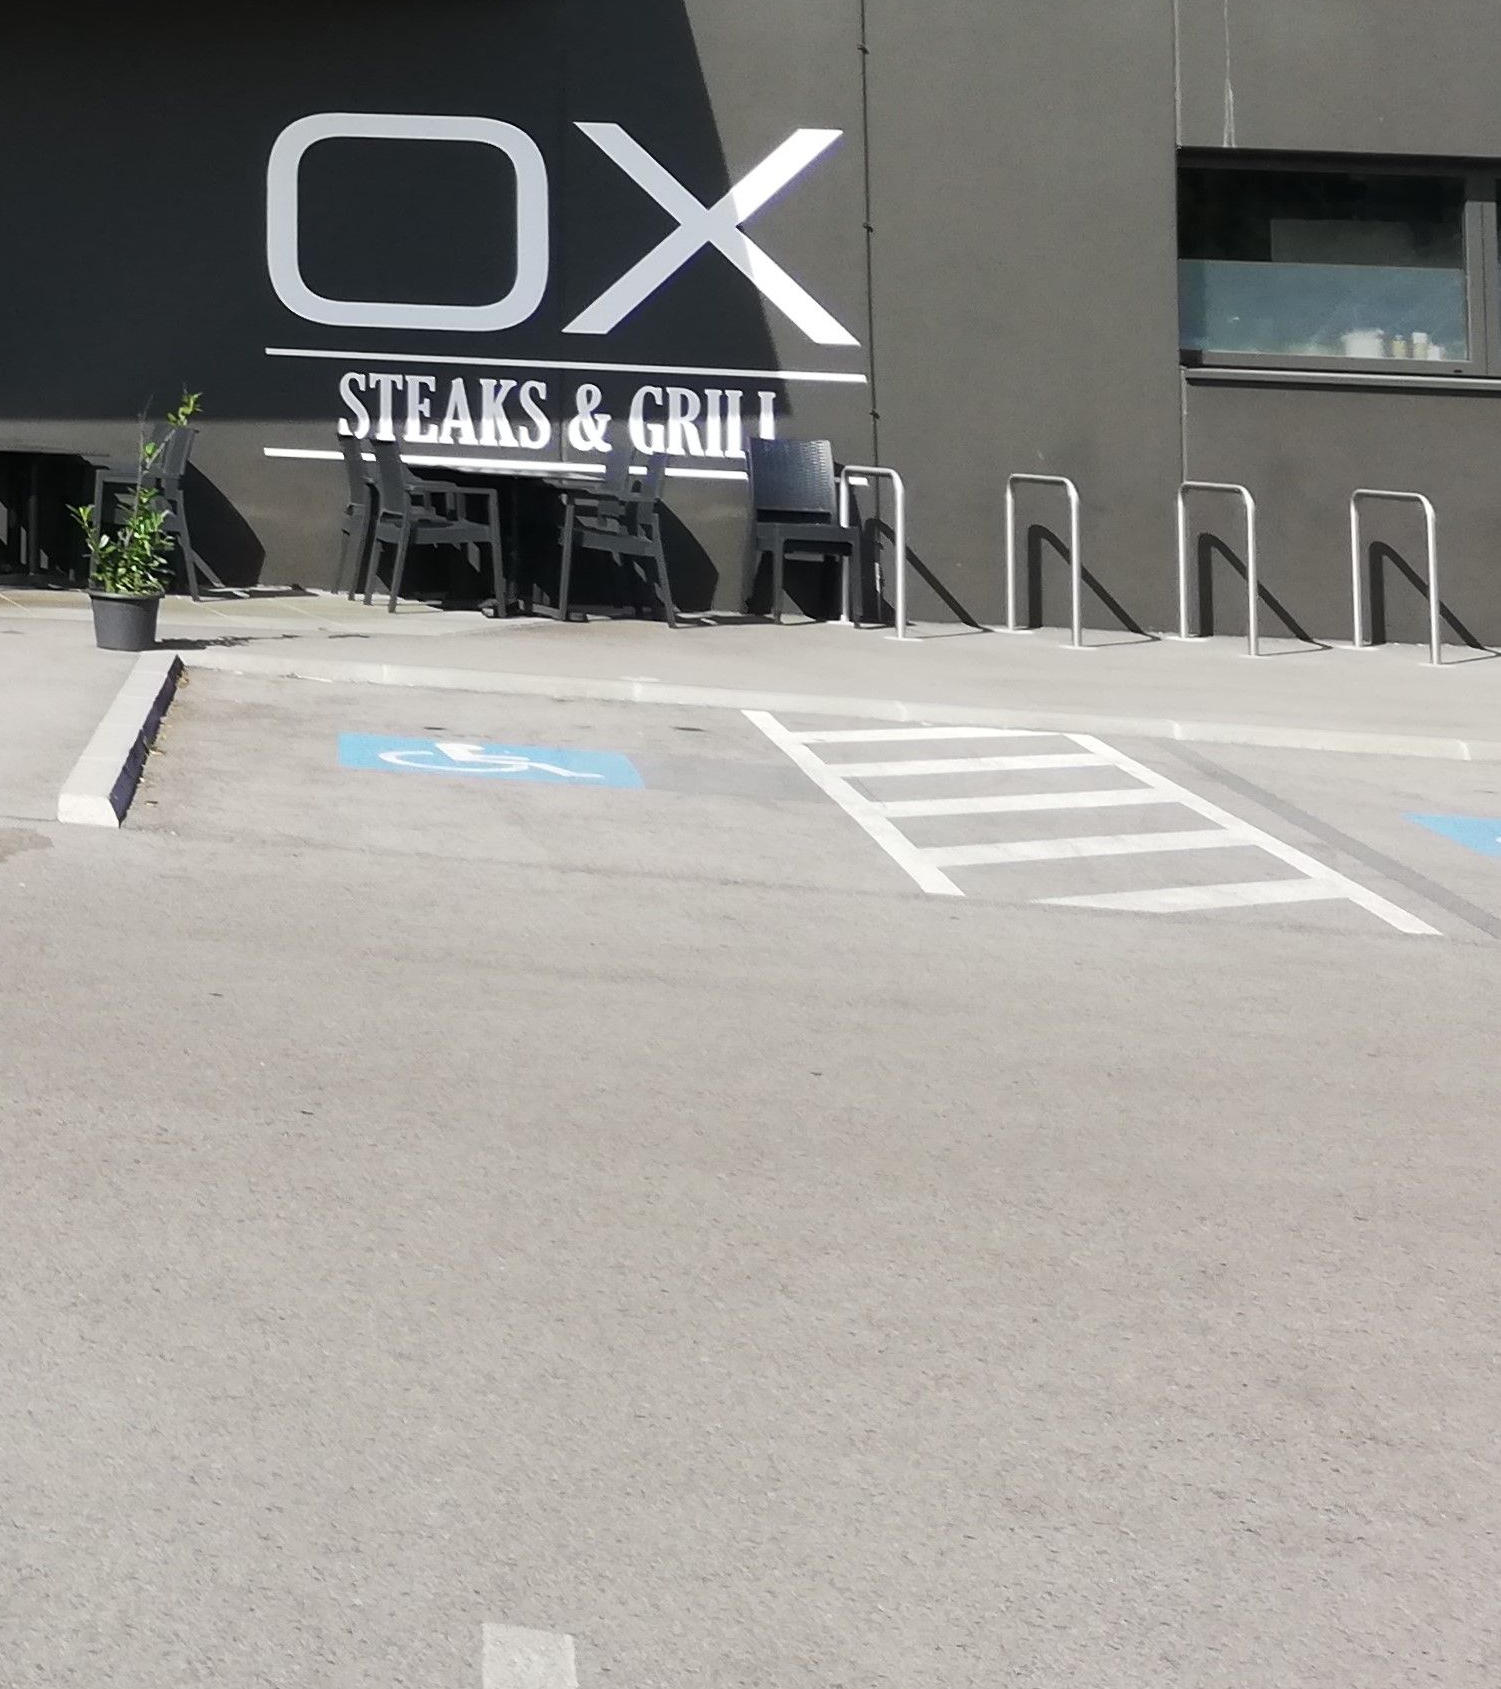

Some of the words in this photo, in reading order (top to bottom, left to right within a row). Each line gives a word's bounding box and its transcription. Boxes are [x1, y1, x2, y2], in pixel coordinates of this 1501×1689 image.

[265, 111, 862, 347] OX
[338, 372, 552, 450] STEAKS
[567, 383, 613, 453] &
